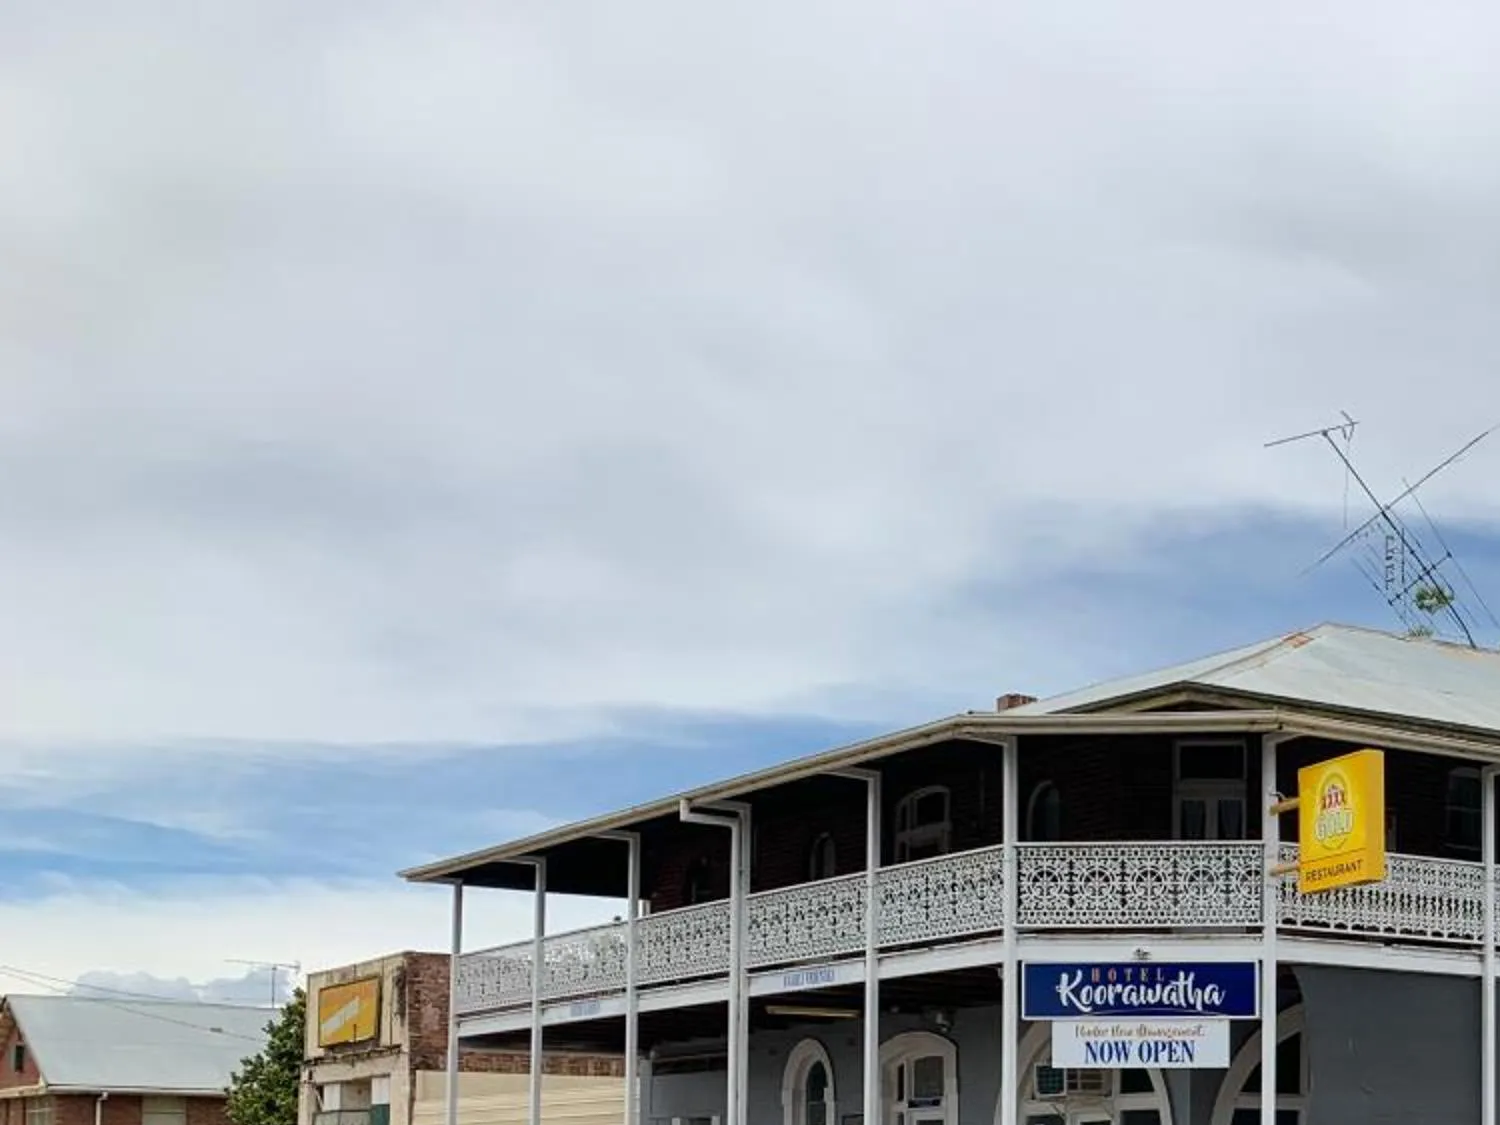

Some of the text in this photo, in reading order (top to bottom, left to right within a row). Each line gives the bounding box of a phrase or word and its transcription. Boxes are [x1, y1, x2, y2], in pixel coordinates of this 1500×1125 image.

[1306, 858, 1362, 882] RESTAURANT
[1091, 967, 1165, 983] HOTEL
[1056, 969, 1227, 1013] Koorawatha
[1085, 1039, 1195, 1064] NOW OPEN
